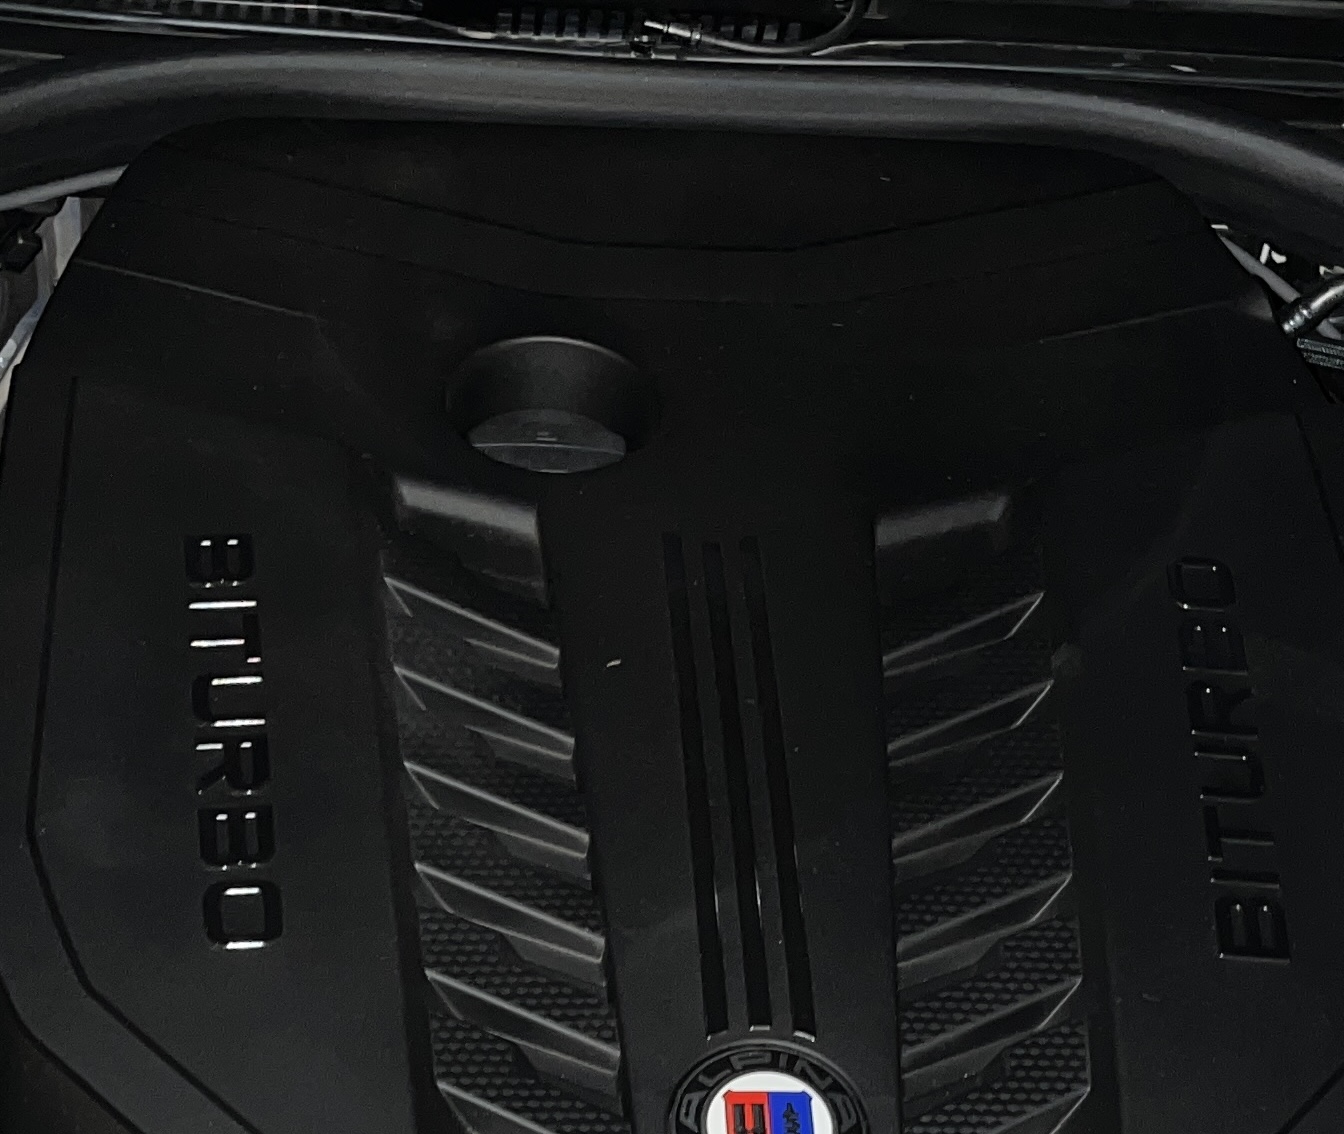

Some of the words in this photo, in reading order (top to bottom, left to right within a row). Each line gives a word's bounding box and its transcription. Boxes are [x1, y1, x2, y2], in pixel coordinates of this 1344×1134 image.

[183, 533, 284, 952] BITURBO
[1166, 555, 1290, 964] BITURBO
[679, 1051, 857, 1133] ALPINA
